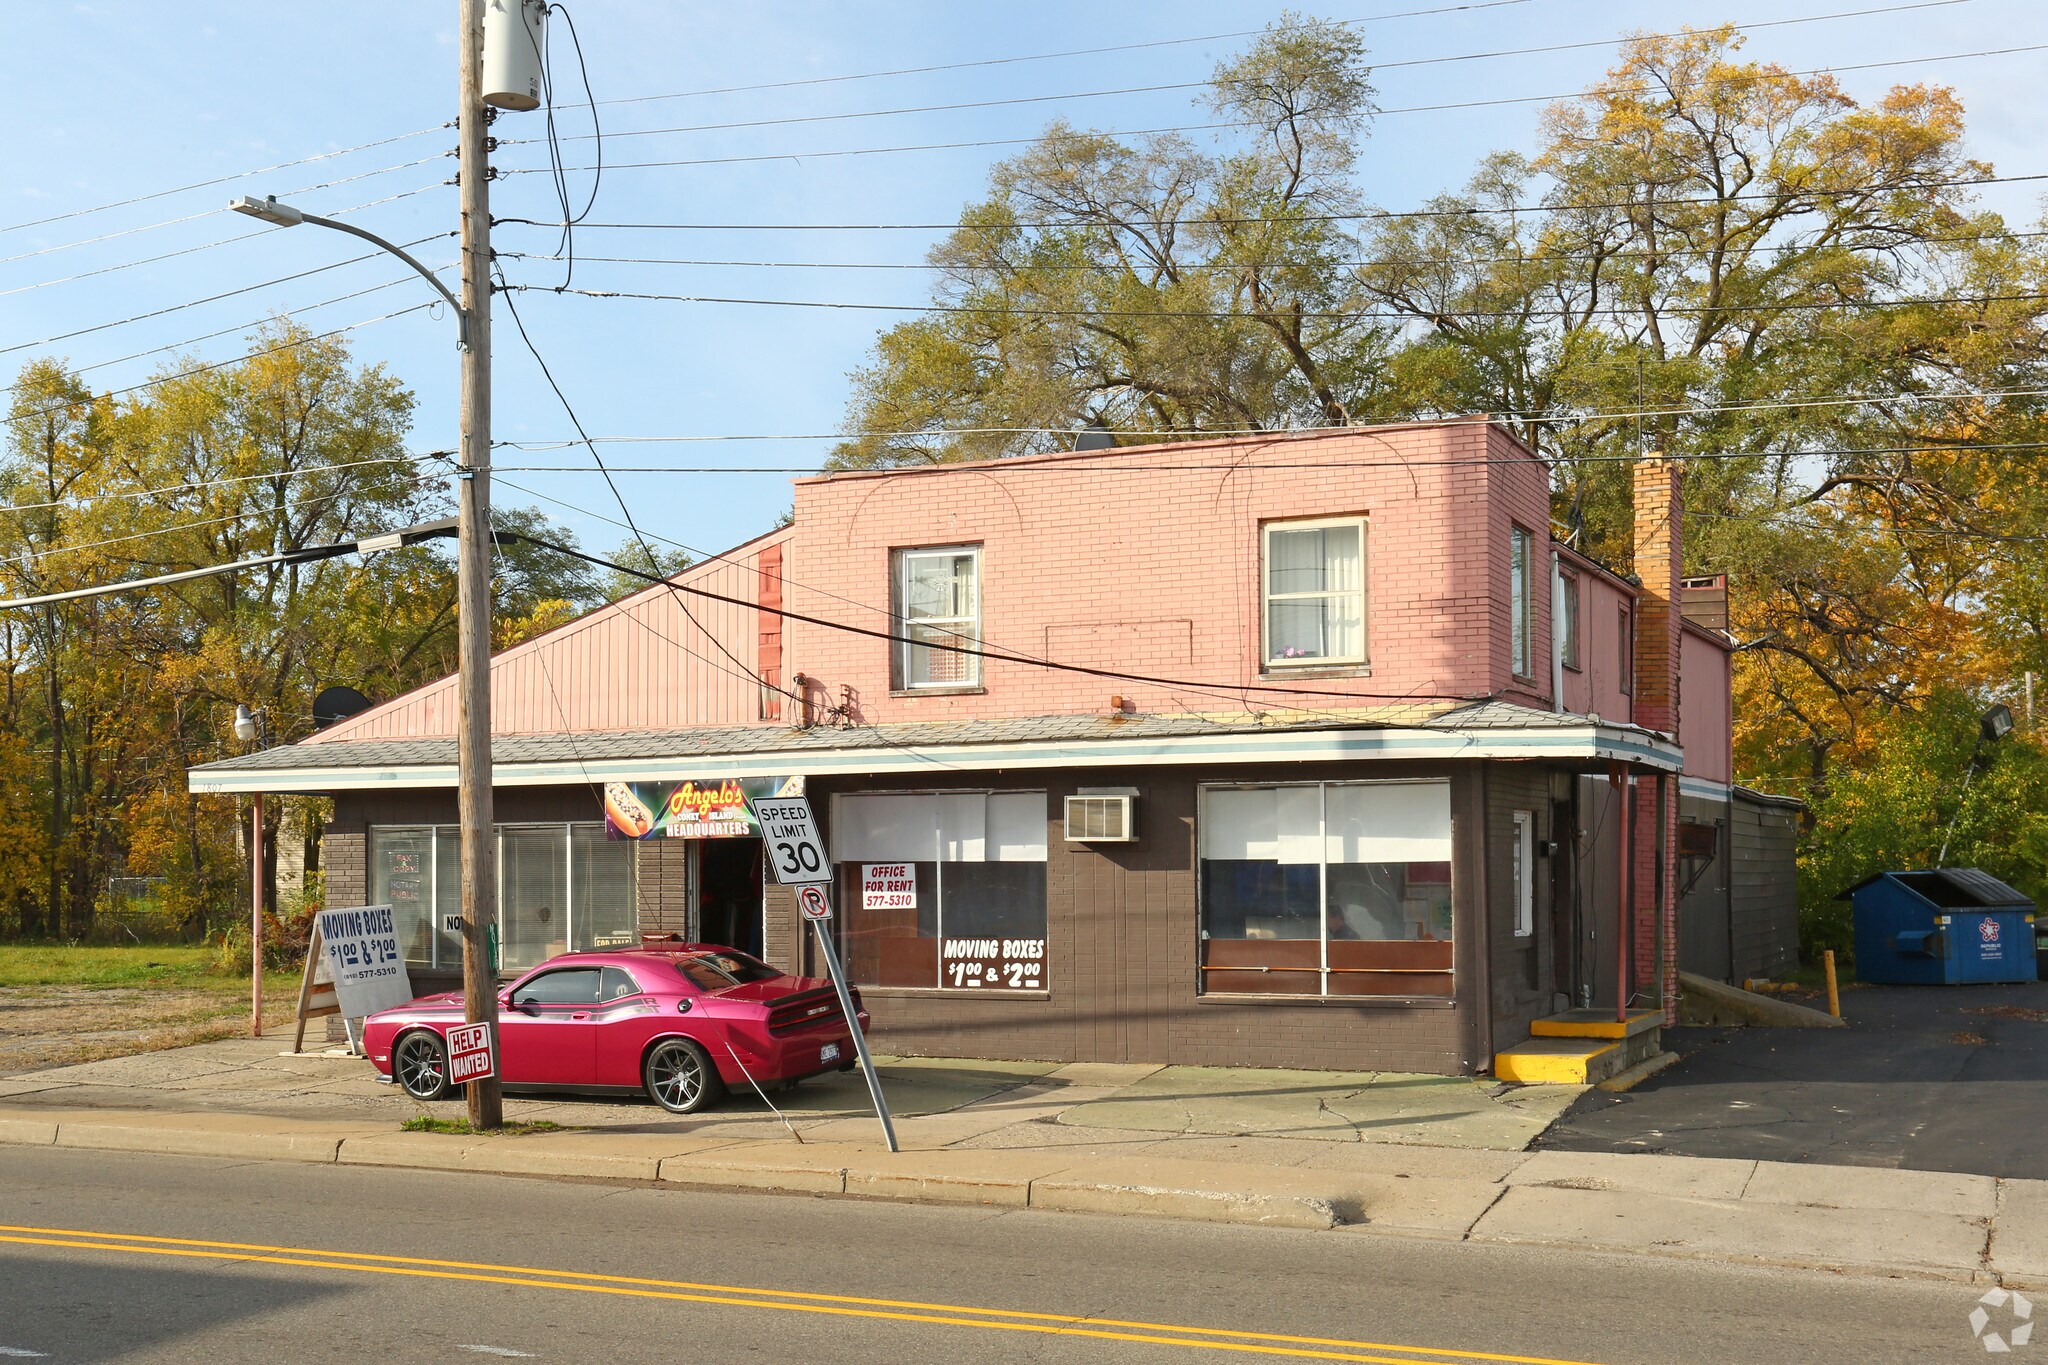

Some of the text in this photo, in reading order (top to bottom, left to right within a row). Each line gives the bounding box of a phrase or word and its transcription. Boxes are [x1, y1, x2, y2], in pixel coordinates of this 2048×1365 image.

[670, 782, 745, 814] Angelo's
[708, 811, 734, 820] ISLAND
[761, 807, 807, 821] SPEED
[666, 821, 750, 837] HEADQUARTERS
[771, 824, 807, 838] LIMIT
[777, 842, 820, 874] 30
[871, 866, 906, 878] OFFICE
[390, 880, 419, 890] NOTARY
[865, 880, 914, 892] FOR RENT
[390, 890, 419, 900] PUBLIC
[866, 894, 912, 907] 577-5310
[322, 908, 393, 940] MOVING BOXES
[360, 940, 373, 966] &
[943, 939, 1045, 959] MOVING BOXES
[358, 966, 397, 979] 577-5310
[985, 967, 999, 982] &
[453, 1029, 482, 1053] HELP
[452, 1051, 489, 1079] WANTED
